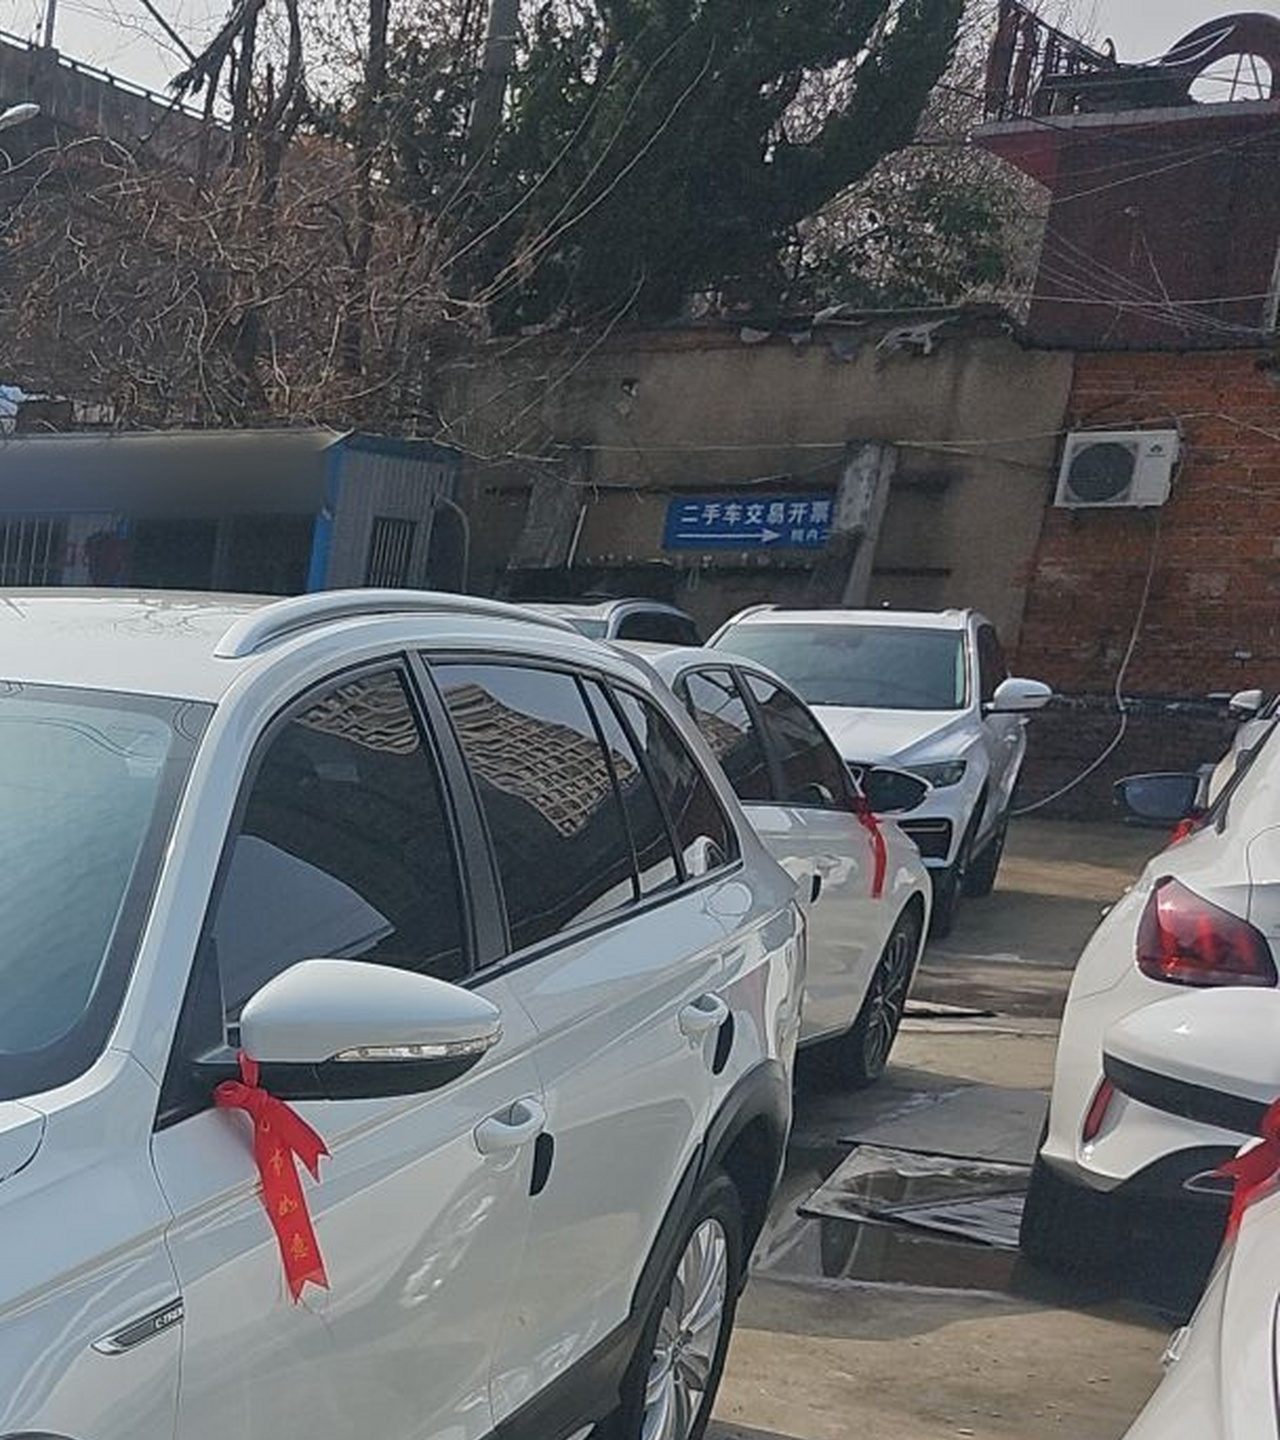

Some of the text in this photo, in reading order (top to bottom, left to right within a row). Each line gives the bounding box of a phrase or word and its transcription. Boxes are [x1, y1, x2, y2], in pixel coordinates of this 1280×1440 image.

[681, 502, 831, 526] 二手车交易开票
